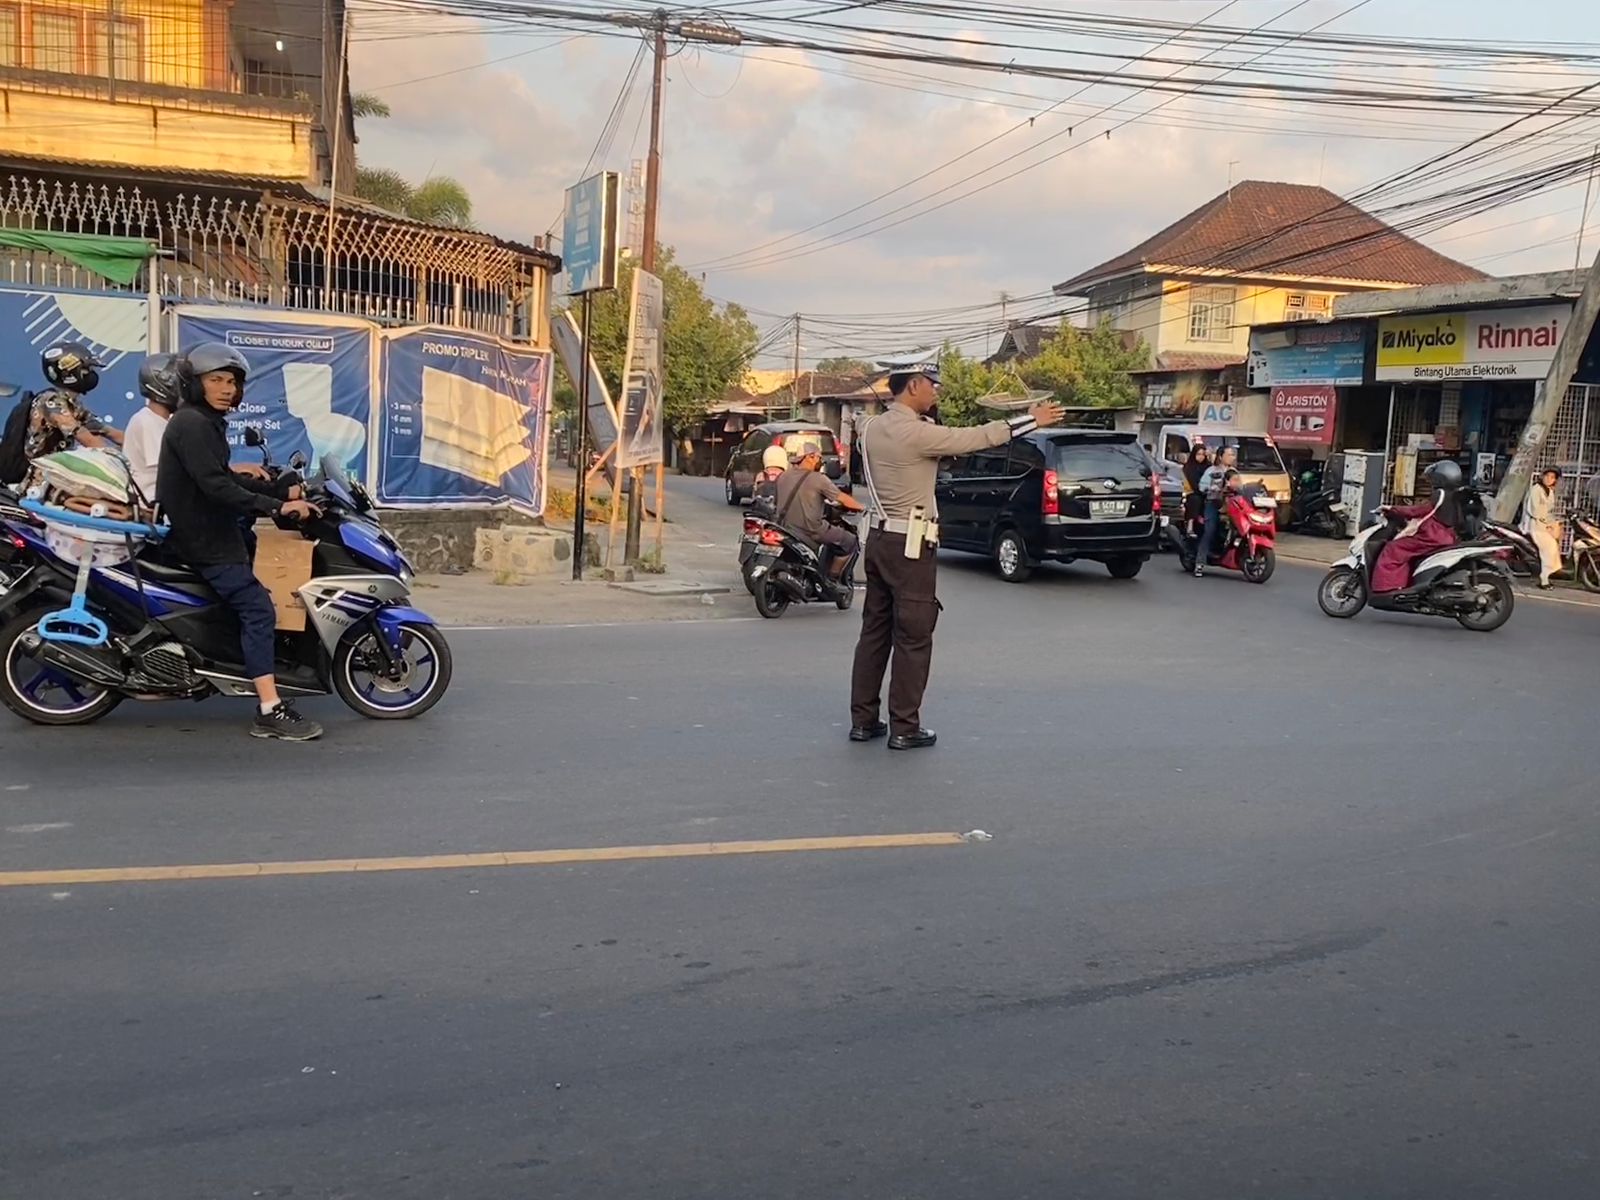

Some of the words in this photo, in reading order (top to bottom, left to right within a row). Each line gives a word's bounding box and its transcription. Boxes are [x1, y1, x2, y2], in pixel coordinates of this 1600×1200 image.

[232, 335, 270, 346] CLOSET
[1397, 326, 1456, 352] Miyako
[1478, 320, 1557, 349] Rinnai
[422, 342, 459, 356] PROMO
[1414, 367, 1443, 378] Bintang
[1444, 366, 1471, 376] Utama
[1473, 365, 1517, 376] Elektronik
[1286, 395, 1328, 406] ARISTON
[238, 402, 267, 413] Close
[1203, 405, 1232, 421] AC
[264, 420, 281, 430] Set
[321, 612, 351, 627] YAMAHA
